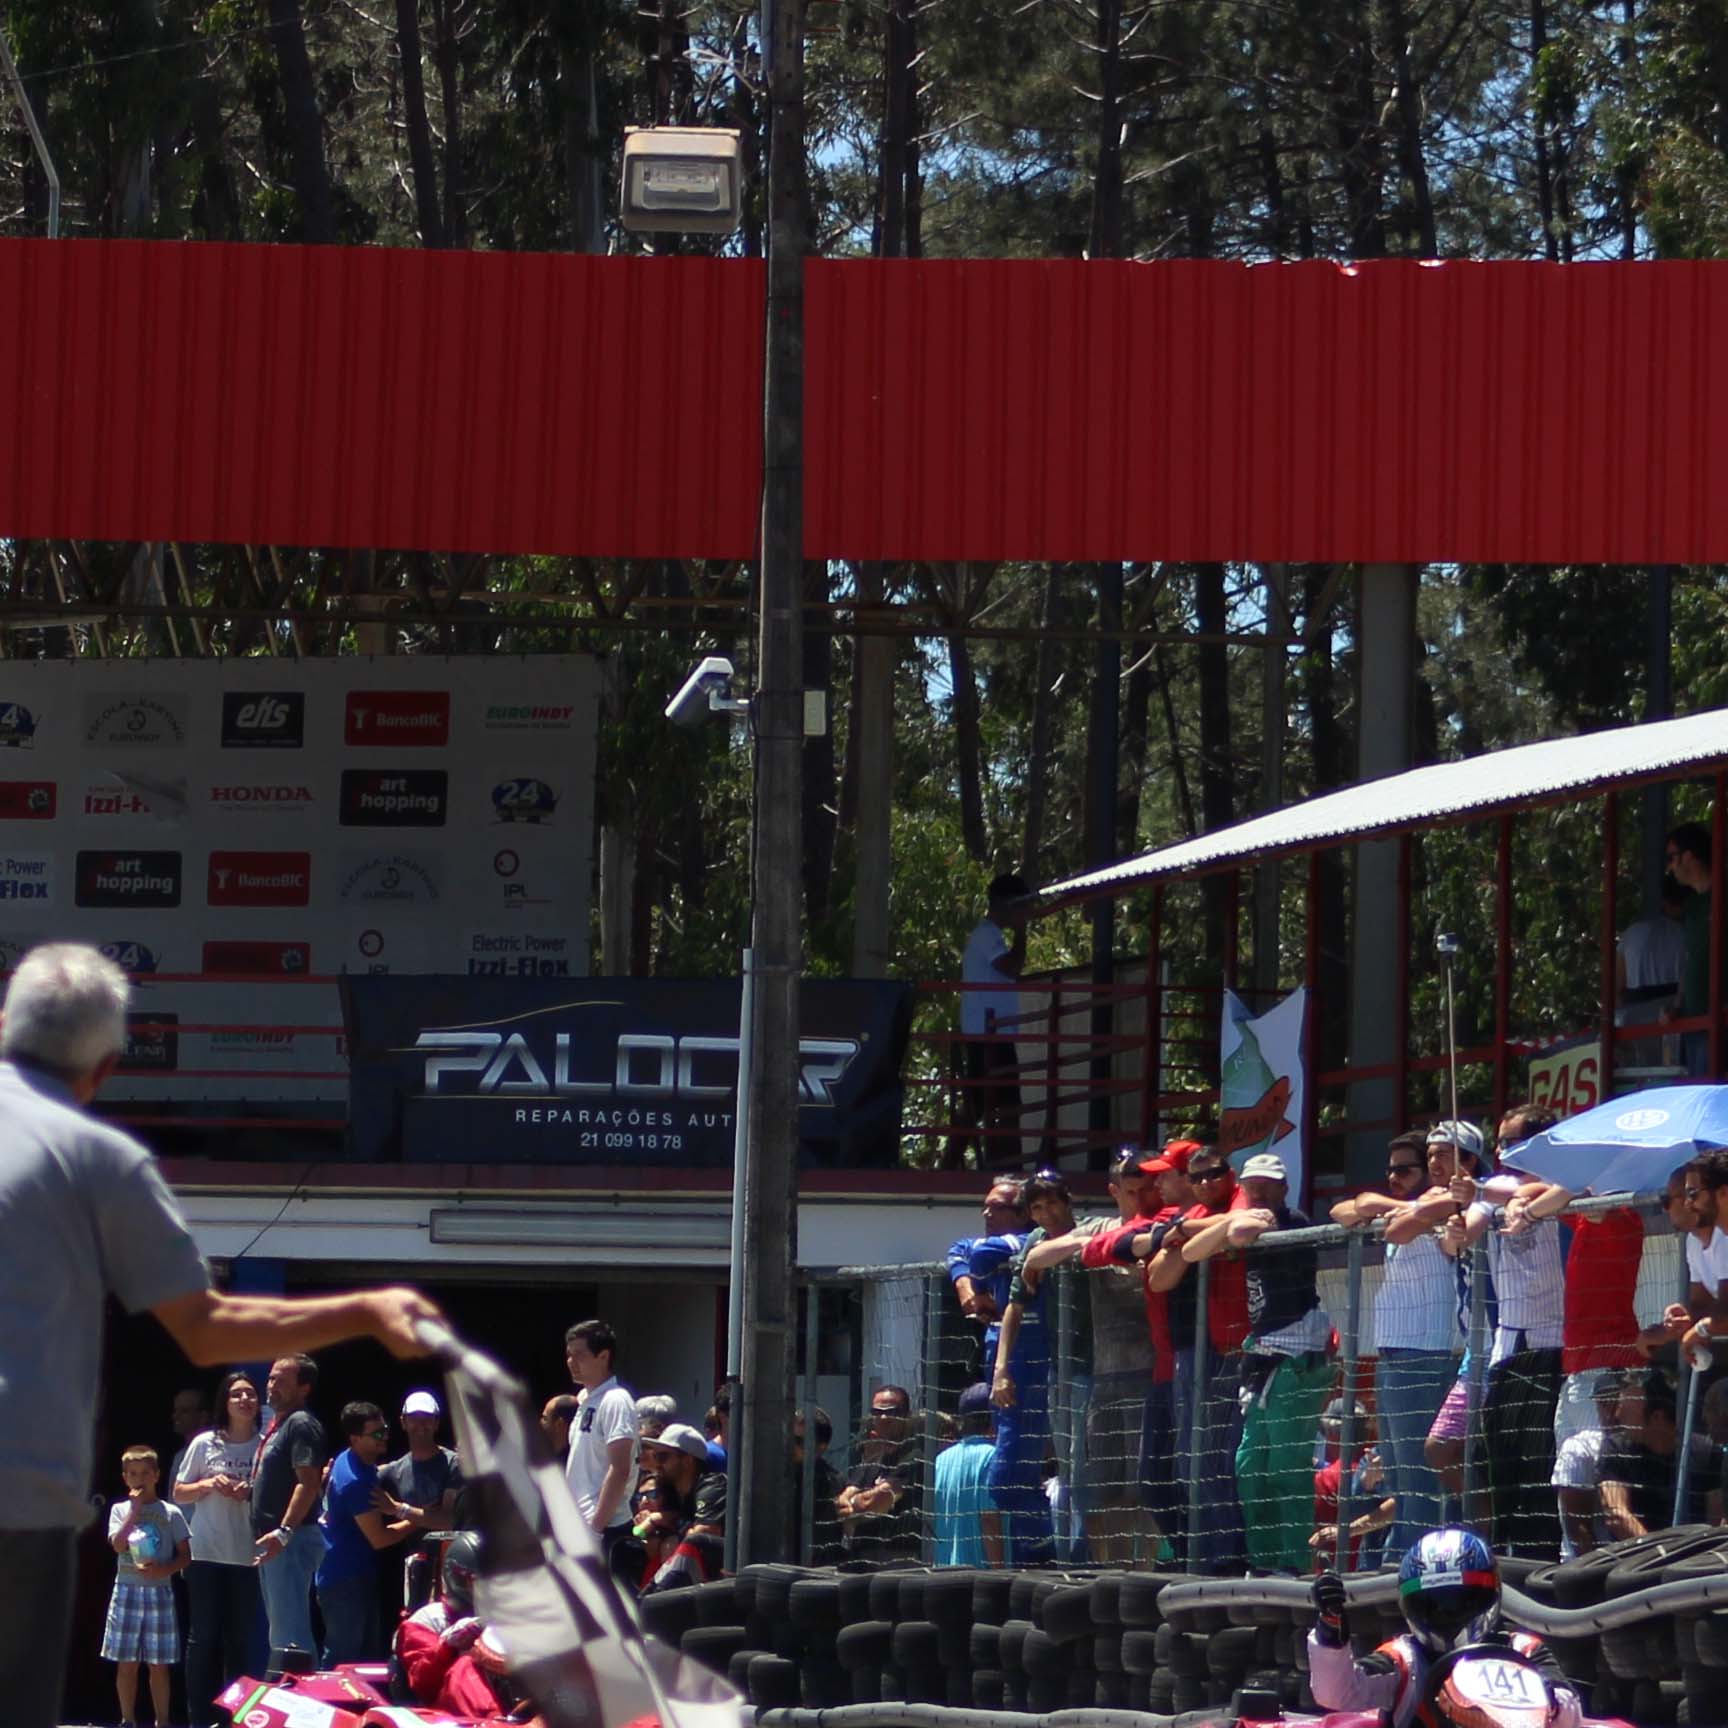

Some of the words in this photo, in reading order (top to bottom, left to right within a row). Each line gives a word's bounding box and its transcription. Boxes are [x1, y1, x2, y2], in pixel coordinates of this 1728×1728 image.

[487, 706, 574, 720] EUROINDY
[211, 787, 313, 801] HONDA
[380, 778, 407, 792] art
[503, 782, 538, 805] 24
[360, 792, 439, 813] hopping
[6, 858, 46, 876] Power
[115, 858, 142, 872] art
[95, 873, 174, 895] hopping
[239, 873, 305, 888] BancoBIC
[472, 934, 520, 952] Electric
[525, 935, 567, 953] Power
[415, 1031, 858, 1099] PALOCR
[515, 1107, 674, 1128] REPARAÇÕES
[688, 1112, 733, 1128] AUT
[580, 1132, 601, 1148] 21
[604, 1132, 633, 1149] 099
[638, 1133, 658, 1150] 18
[662, 1134, 682, 1151] 78
[1478, 1664, 1529, 1697] 141
